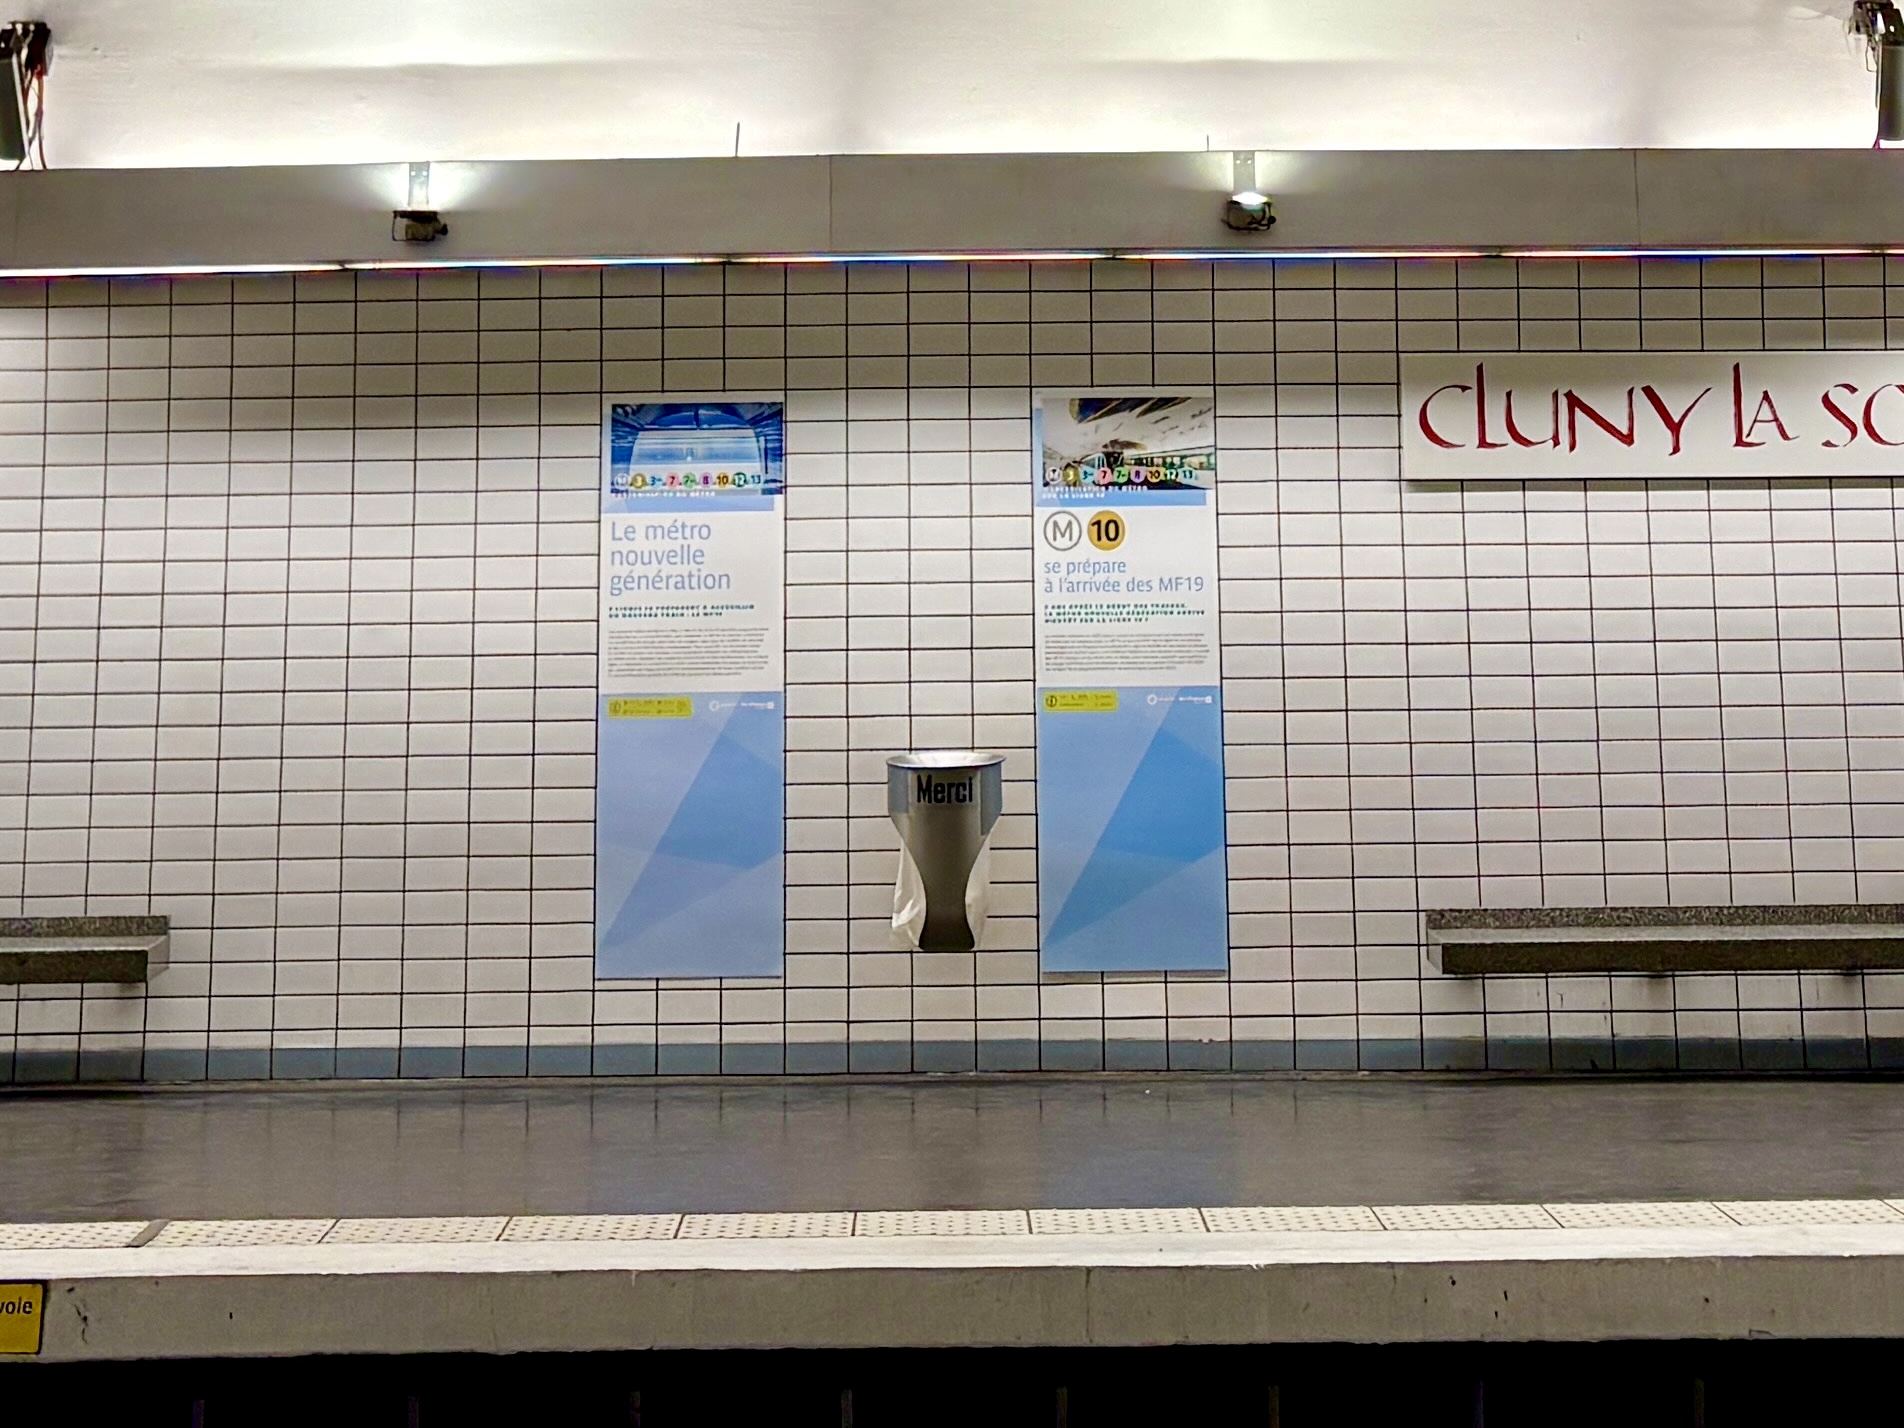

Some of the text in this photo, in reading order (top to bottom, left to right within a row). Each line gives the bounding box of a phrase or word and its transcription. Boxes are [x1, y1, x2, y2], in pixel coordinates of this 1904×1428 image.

[1417, 360, 1714, 456] CLUNY
[1731, 361, 1800, 450] LA
[610, 518, 712, 542] Le métro
[1090, 518, 1121, 542] 10
[610, 544, 706, 567] nouvelle
[1044, 558, 1127, 577] se prépare
[609, 568, 732, 597] génération
[1044, 578, 1054, 593] à
[1125, 576, 1154, 593] des
[1158, 575, 1205, 593] MF19
[916, 773, 974, 805] Merci
